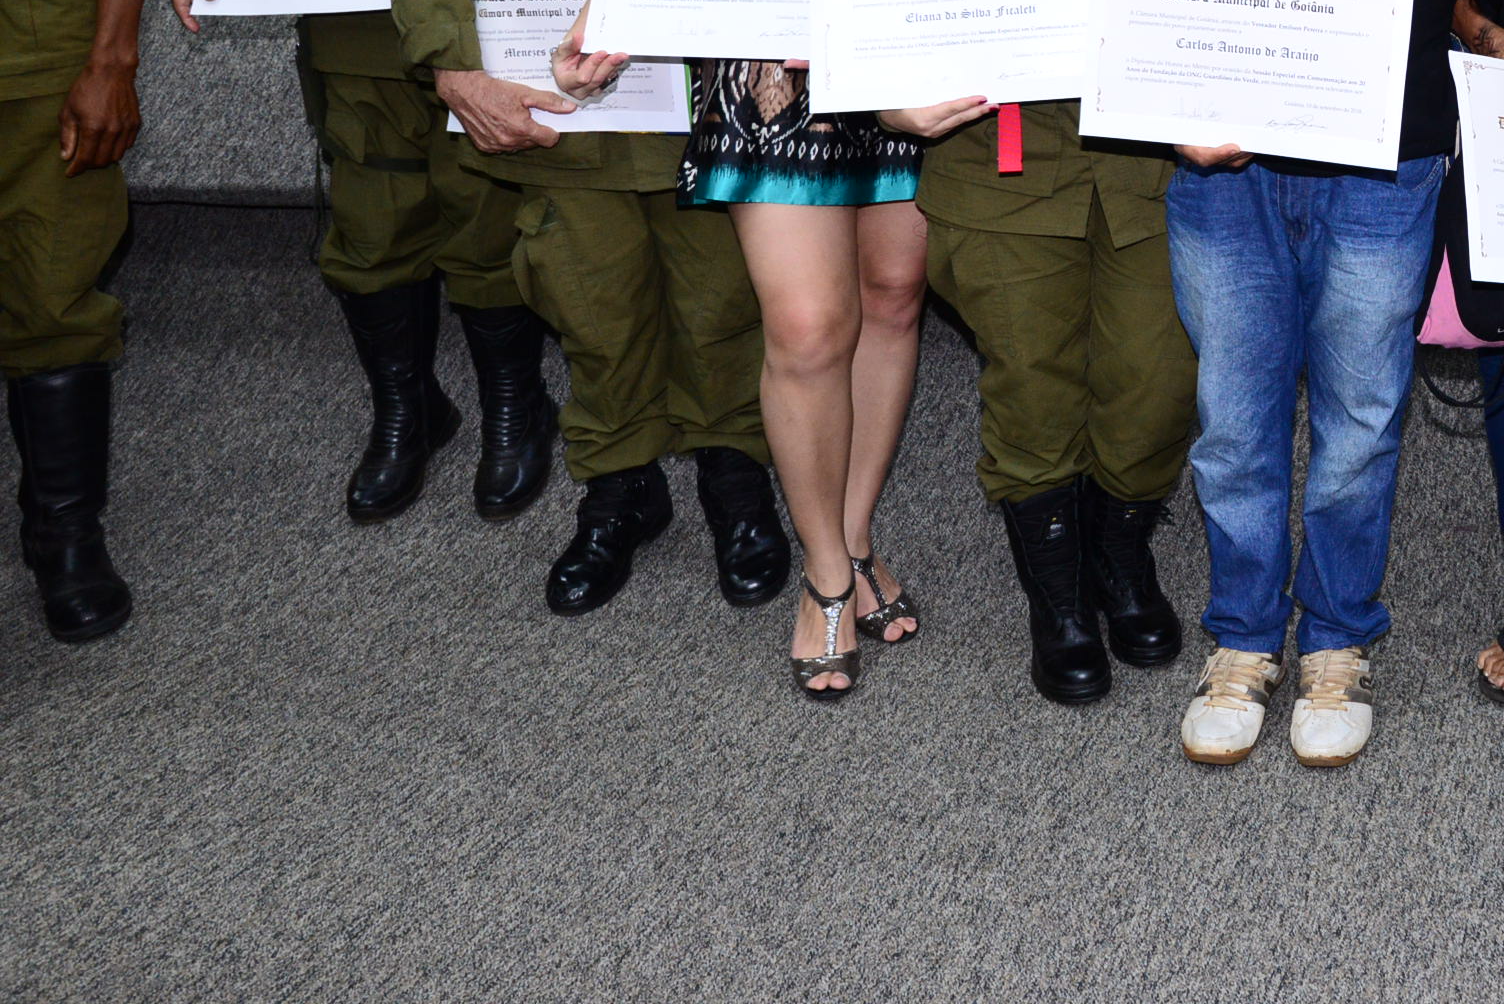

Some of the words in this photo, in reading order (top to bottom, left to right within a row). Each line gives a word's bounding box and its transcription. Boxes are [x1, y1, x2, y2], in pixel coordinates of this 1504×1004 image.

[478, 8, 512, 18] Câmara
[516, 8, 562, 18] Municipal
[566, 8, 576, 16] de
[1291, 0, 1334, 15] Goiânia
[905, 12, 941, 23] Eliana
[945, 11, 956, 20] da
[960, 9, 991, 19] Silva
[505, 48, 546, 58] Menezes
[1176, 38, 1213, 52] Carlos
[1218, 41, 1261, 57] Antonio
[1265, 45, 1277, 58] de
[1280, 48, 1319, 62] Araújo
